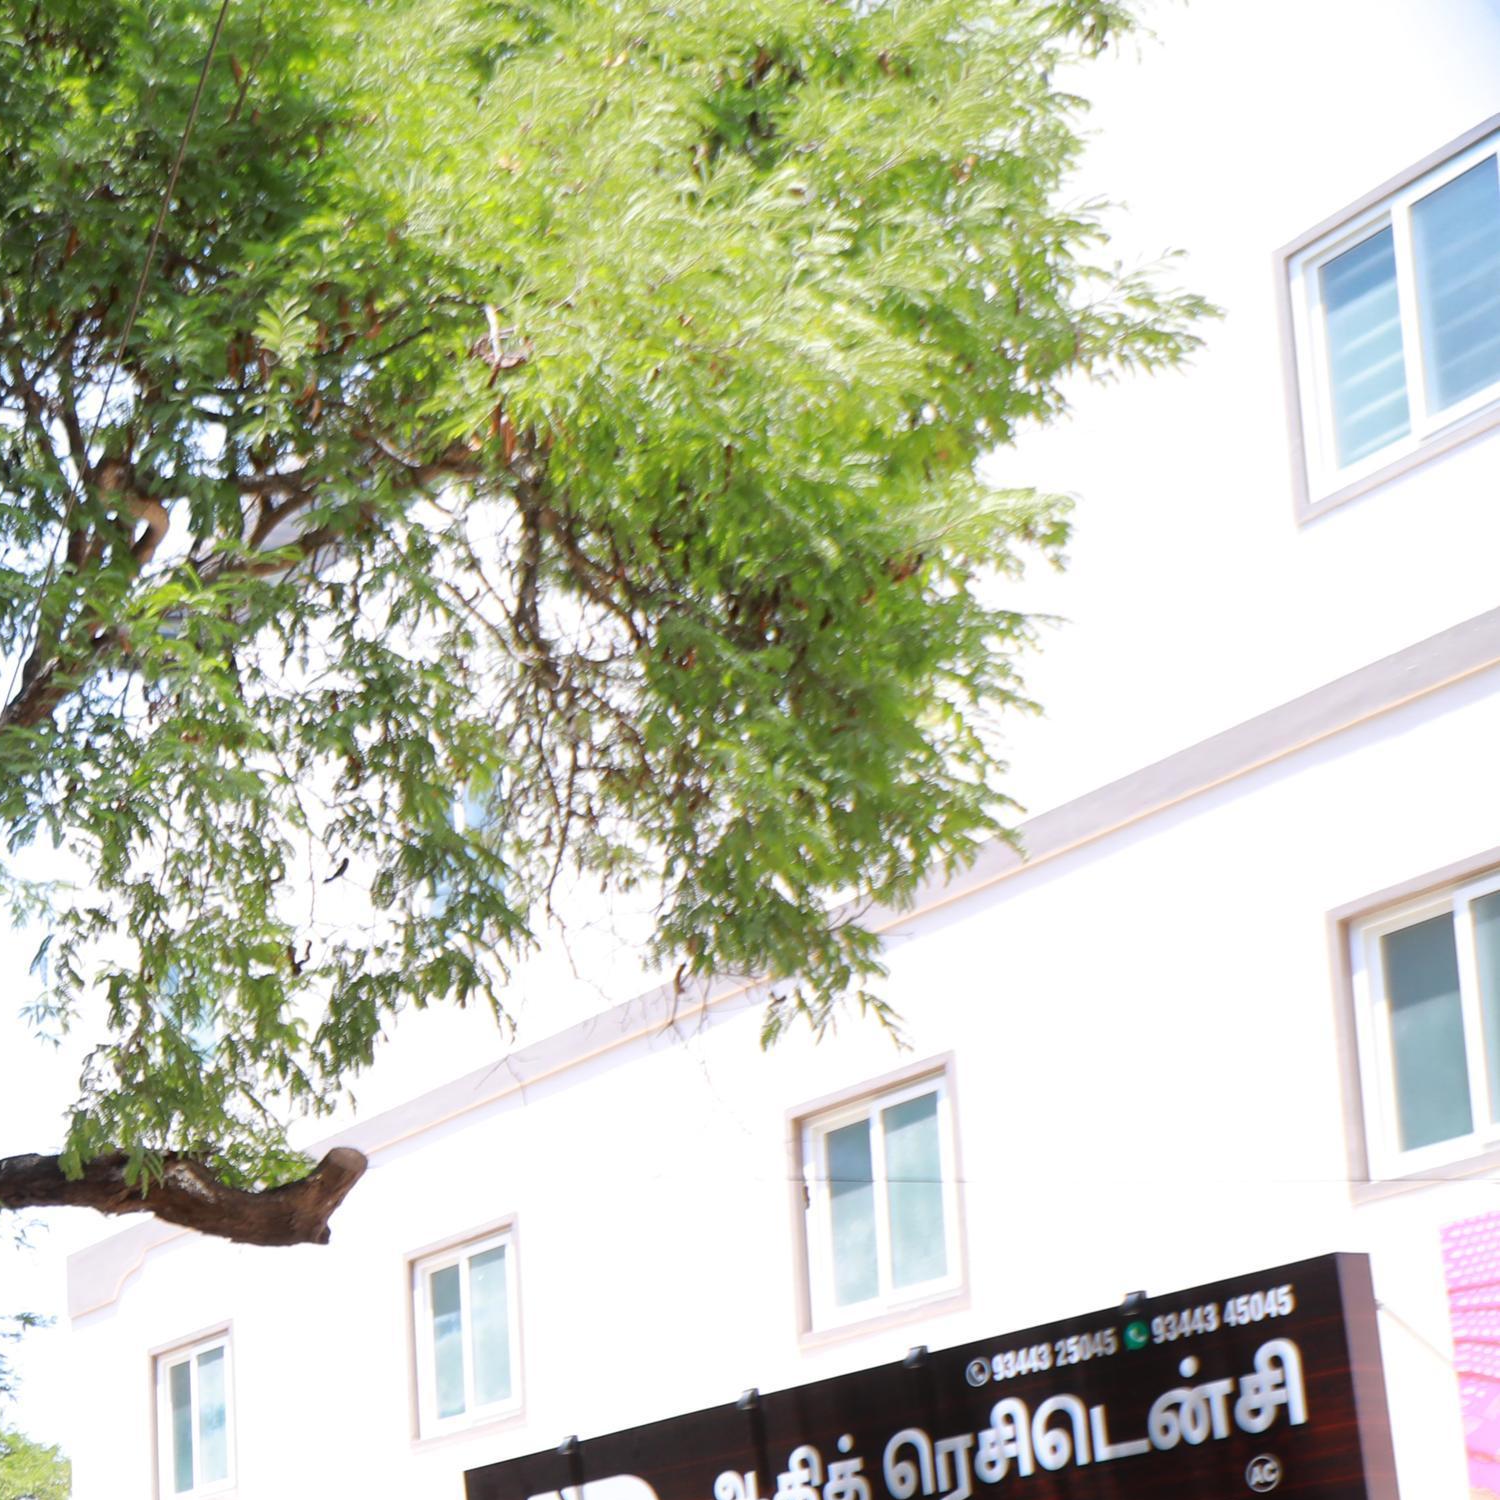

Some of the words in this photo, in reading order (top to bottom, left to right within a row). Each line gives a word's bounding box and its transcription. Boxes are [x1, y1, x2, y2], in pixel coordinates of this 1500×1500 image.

[1151, 1303, 1220, 1344] 93443
[1223, 1284, 1295, 1327] 45045
[991, 1343, 1053, 1381] 93443
[1054, 1328, 1118, 1367] 25045
